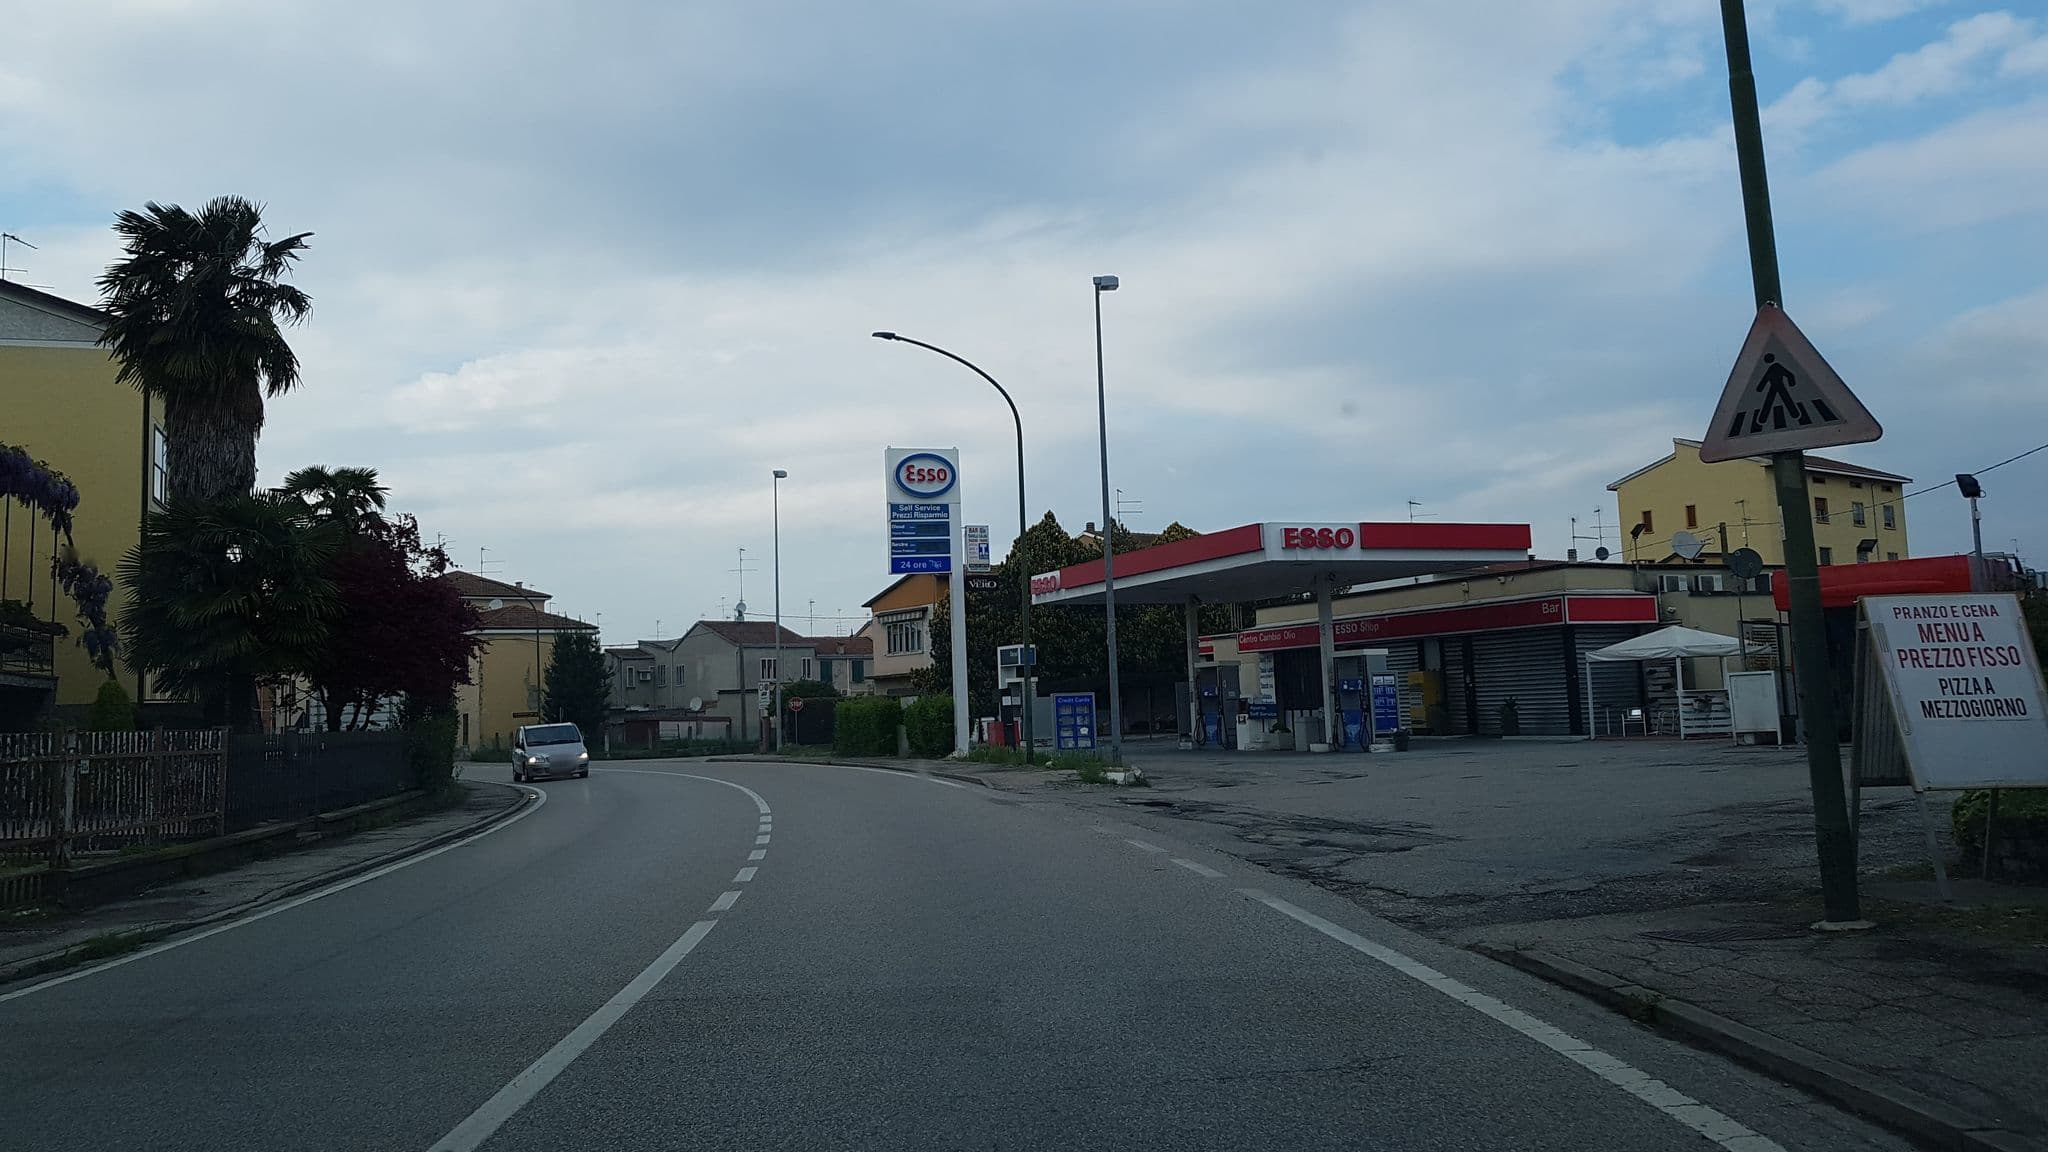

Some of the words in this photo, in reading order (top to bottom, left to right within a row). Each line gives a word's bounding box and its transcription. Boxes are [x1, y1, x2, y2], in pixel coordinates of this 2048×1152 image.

[1281, 526, 1355, 550] ESSO
[1542, 602, 1560, 614] Bar
[1893, 605, 1948, 620] PRANZO
[1951, 605, 1960, 618] E
[1962, 604, 1999, 618] CENA
[1335, 623, 1358, 634] ESSO
[1359, 620, 1379, 633] Shop
[1917, 622, 1969, 643] MENU
[1972, 622, 1985, 642] A
[1238, 631, 1258, 645] Centro
[1259, 631, 1281, 642] Cambio
[1897, 647, 1966, 669] PREZZO
[1969, 645, 2021, 667] FISSO
[1938, 677, 1982, 696] PIZZA
[1984, 676, 1995, 695] A
[1920, 697, 2027, 719] MEZZOGIORNO
